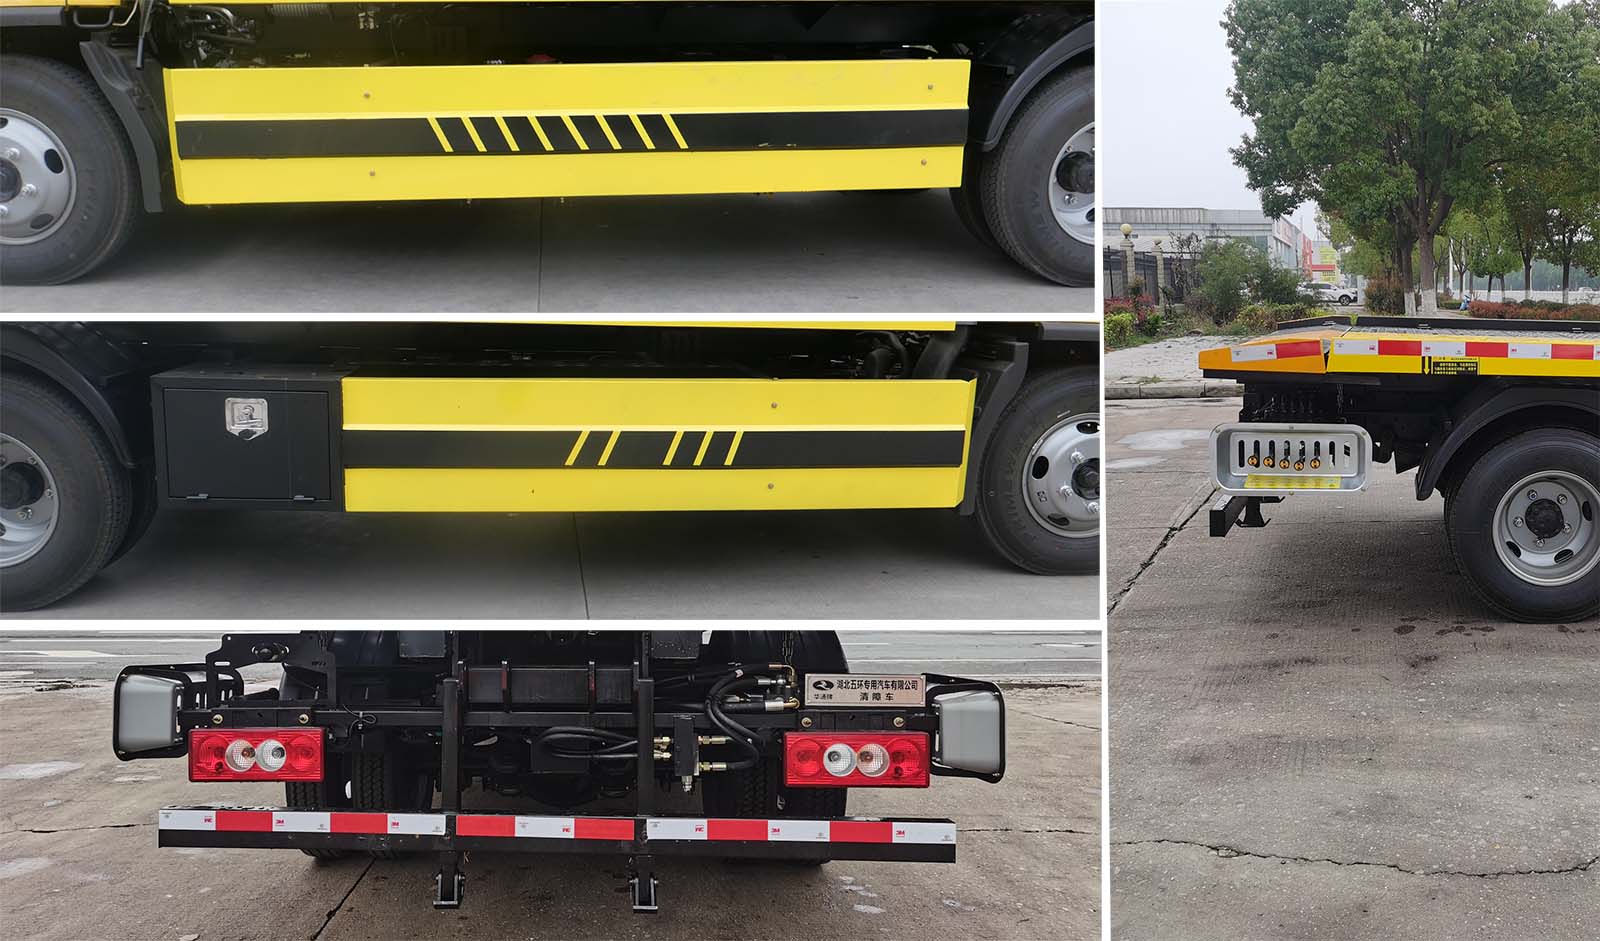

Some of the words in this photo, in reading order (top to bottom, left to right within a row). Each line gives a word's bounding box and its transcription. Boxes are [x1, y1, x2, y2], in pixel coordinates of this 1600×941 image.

[836, 679, 918, 690] 湖北五环专用汽车有限公司
[859, 692, 894, 701] 清障车
